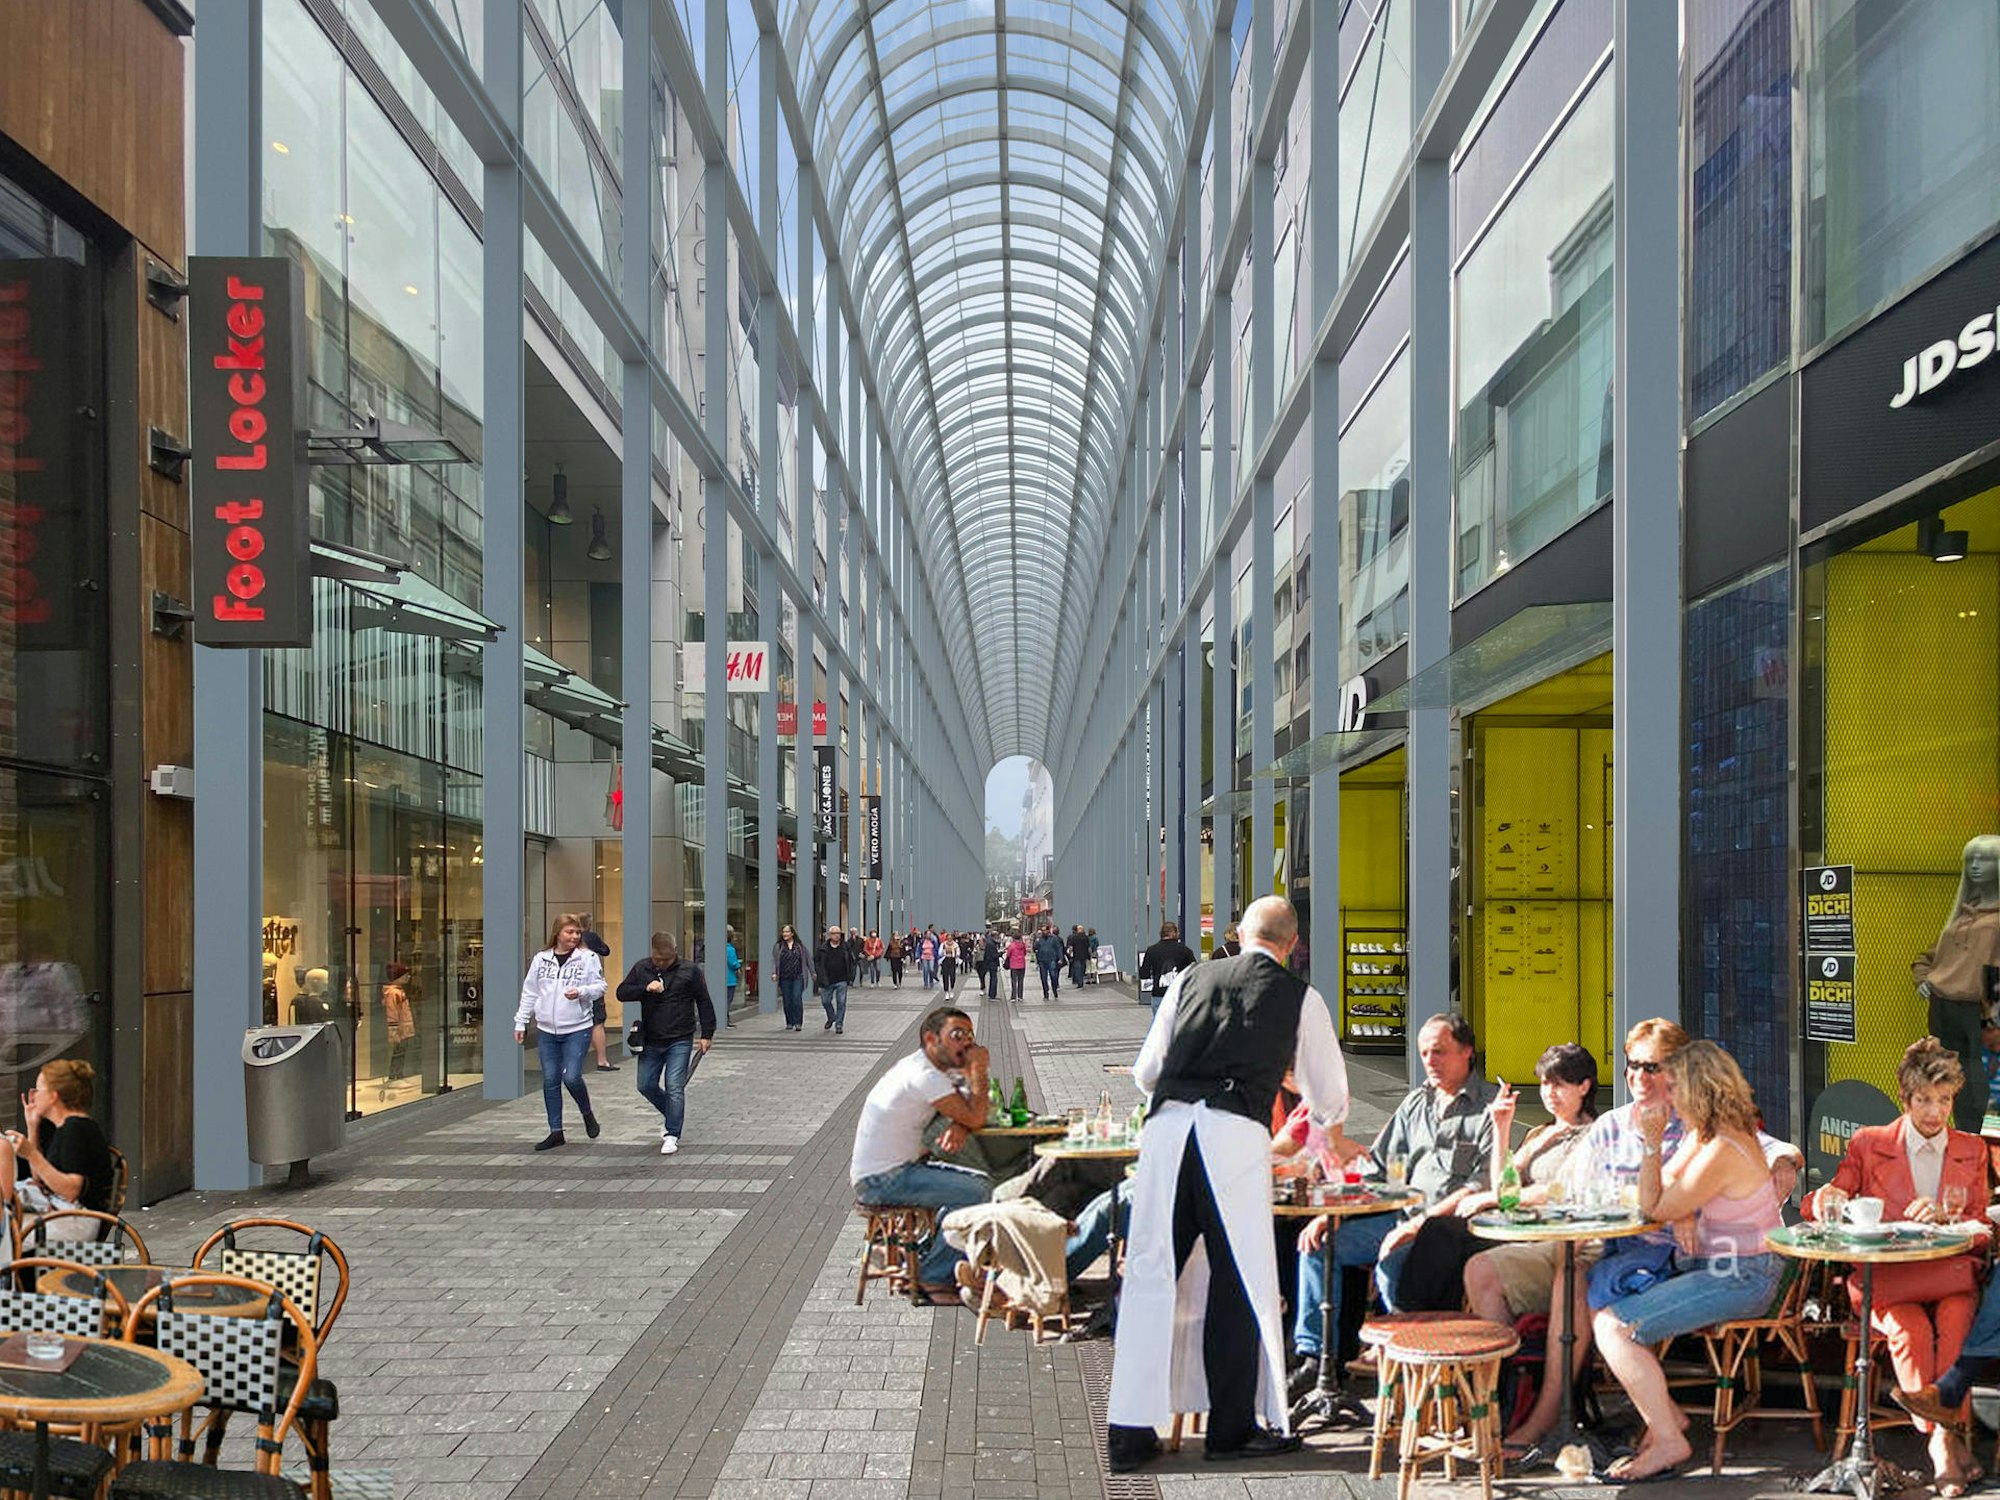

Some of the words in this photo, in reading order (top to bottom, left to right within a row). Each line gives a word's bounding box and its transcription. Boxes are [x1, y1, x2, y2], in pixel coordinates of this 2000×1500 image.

[1889, 304, 2000, 409] JDS
[213, 276, 268, 471] Locker
[213, 499, 266, 622] Foot
[727, 652, 764, 682] H&M
[812, 713, 827, 722] MA
[822, 765, 832, 835] JACK&JONES
[1808, 900, 1850, 916] DICH!
[1824, 962, 1836, 972] JD
[1809, 986, 1852, 1003] DICH!
[1820, 1115, 1866, 1139] ANGE
[1820, 1133, 1840, 1156] IM
